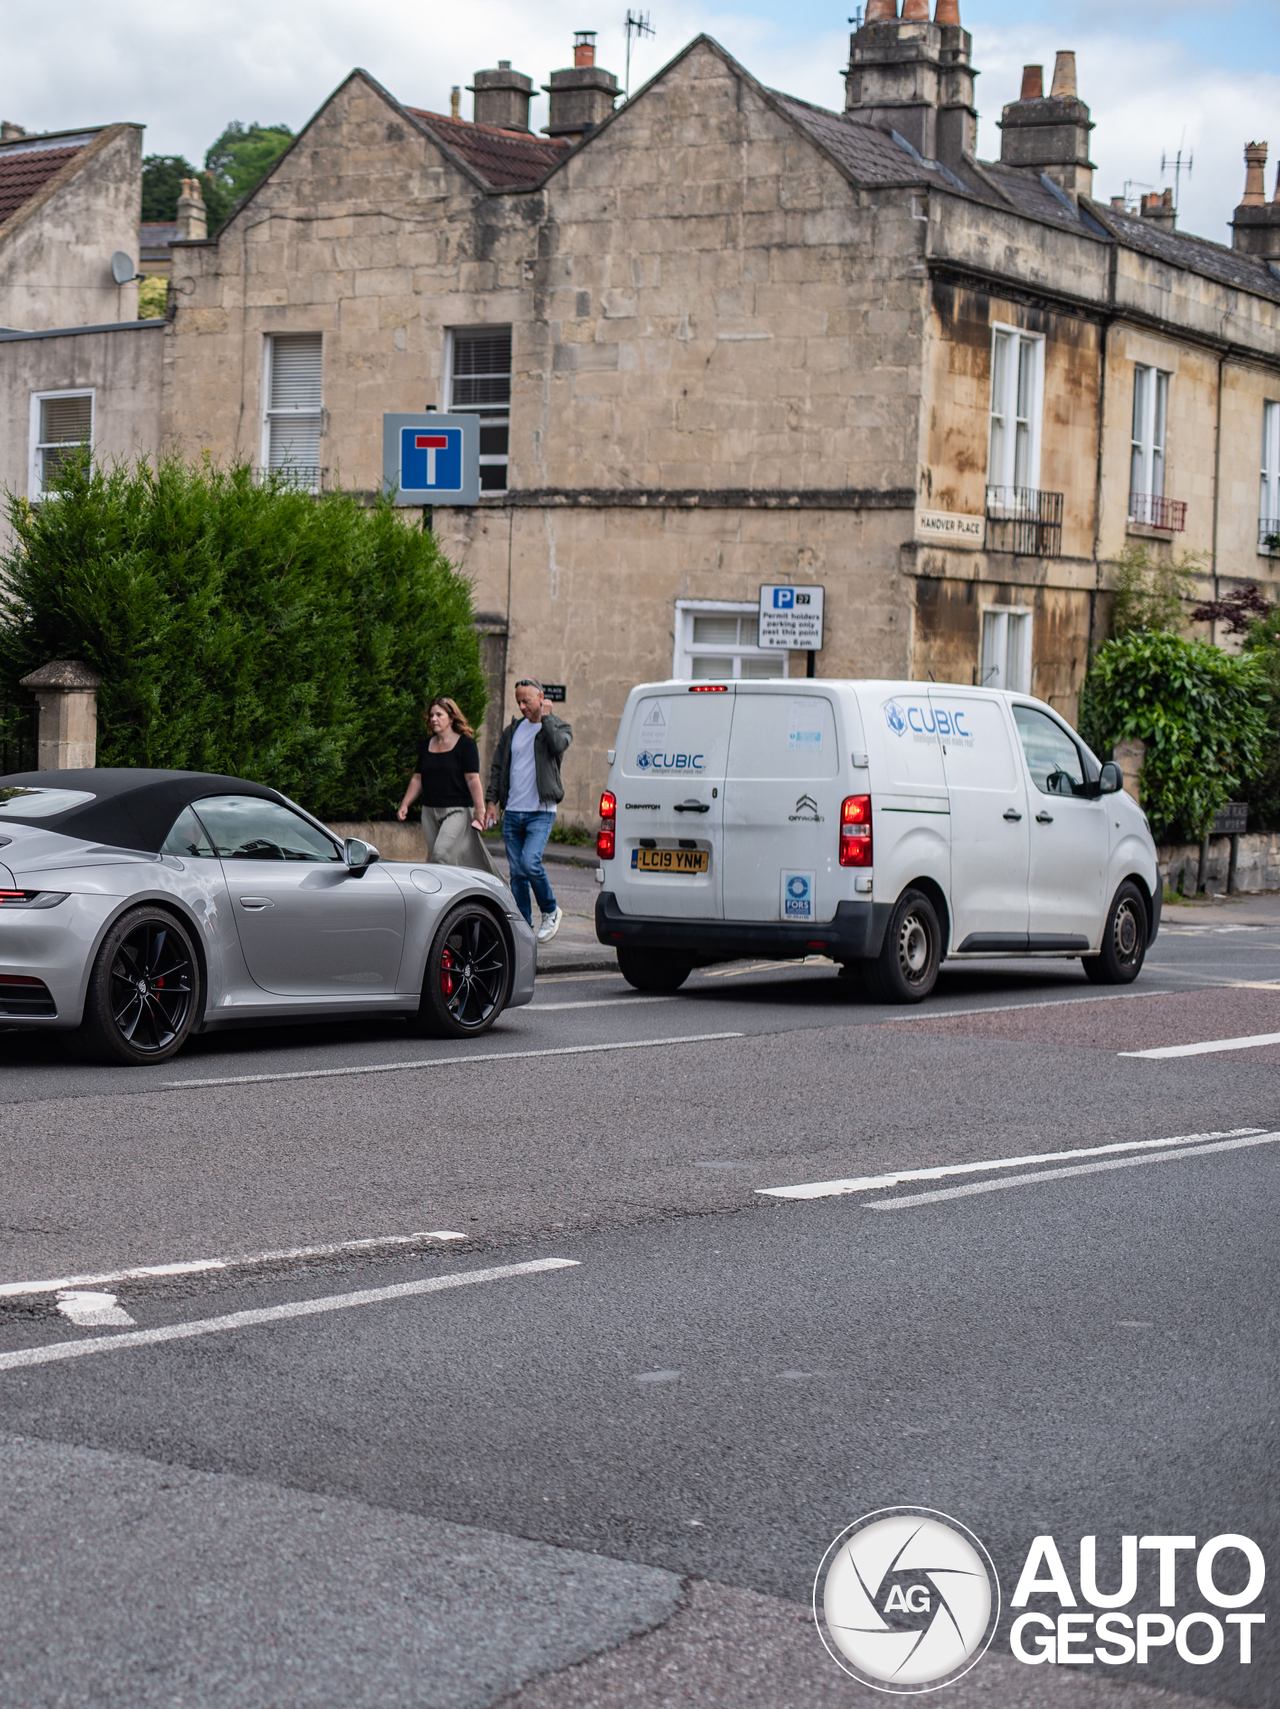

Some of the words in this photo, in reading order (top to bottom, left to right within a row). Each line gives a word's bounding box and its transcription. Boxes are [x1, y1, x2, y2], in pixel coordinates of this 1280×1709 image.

[921, 517, 955, 532] HANOVER
[957, 520, 980, 534] PLACE
[778, 591, 791, 607] P
[907, 707, 969, 737] CUBIC
[653, 753, 704, 769] CUBIC
[642, 851, 672, 867] LC19
[676, 852, 702, 869] YNM
[787, 900, 809, 909] FORS
